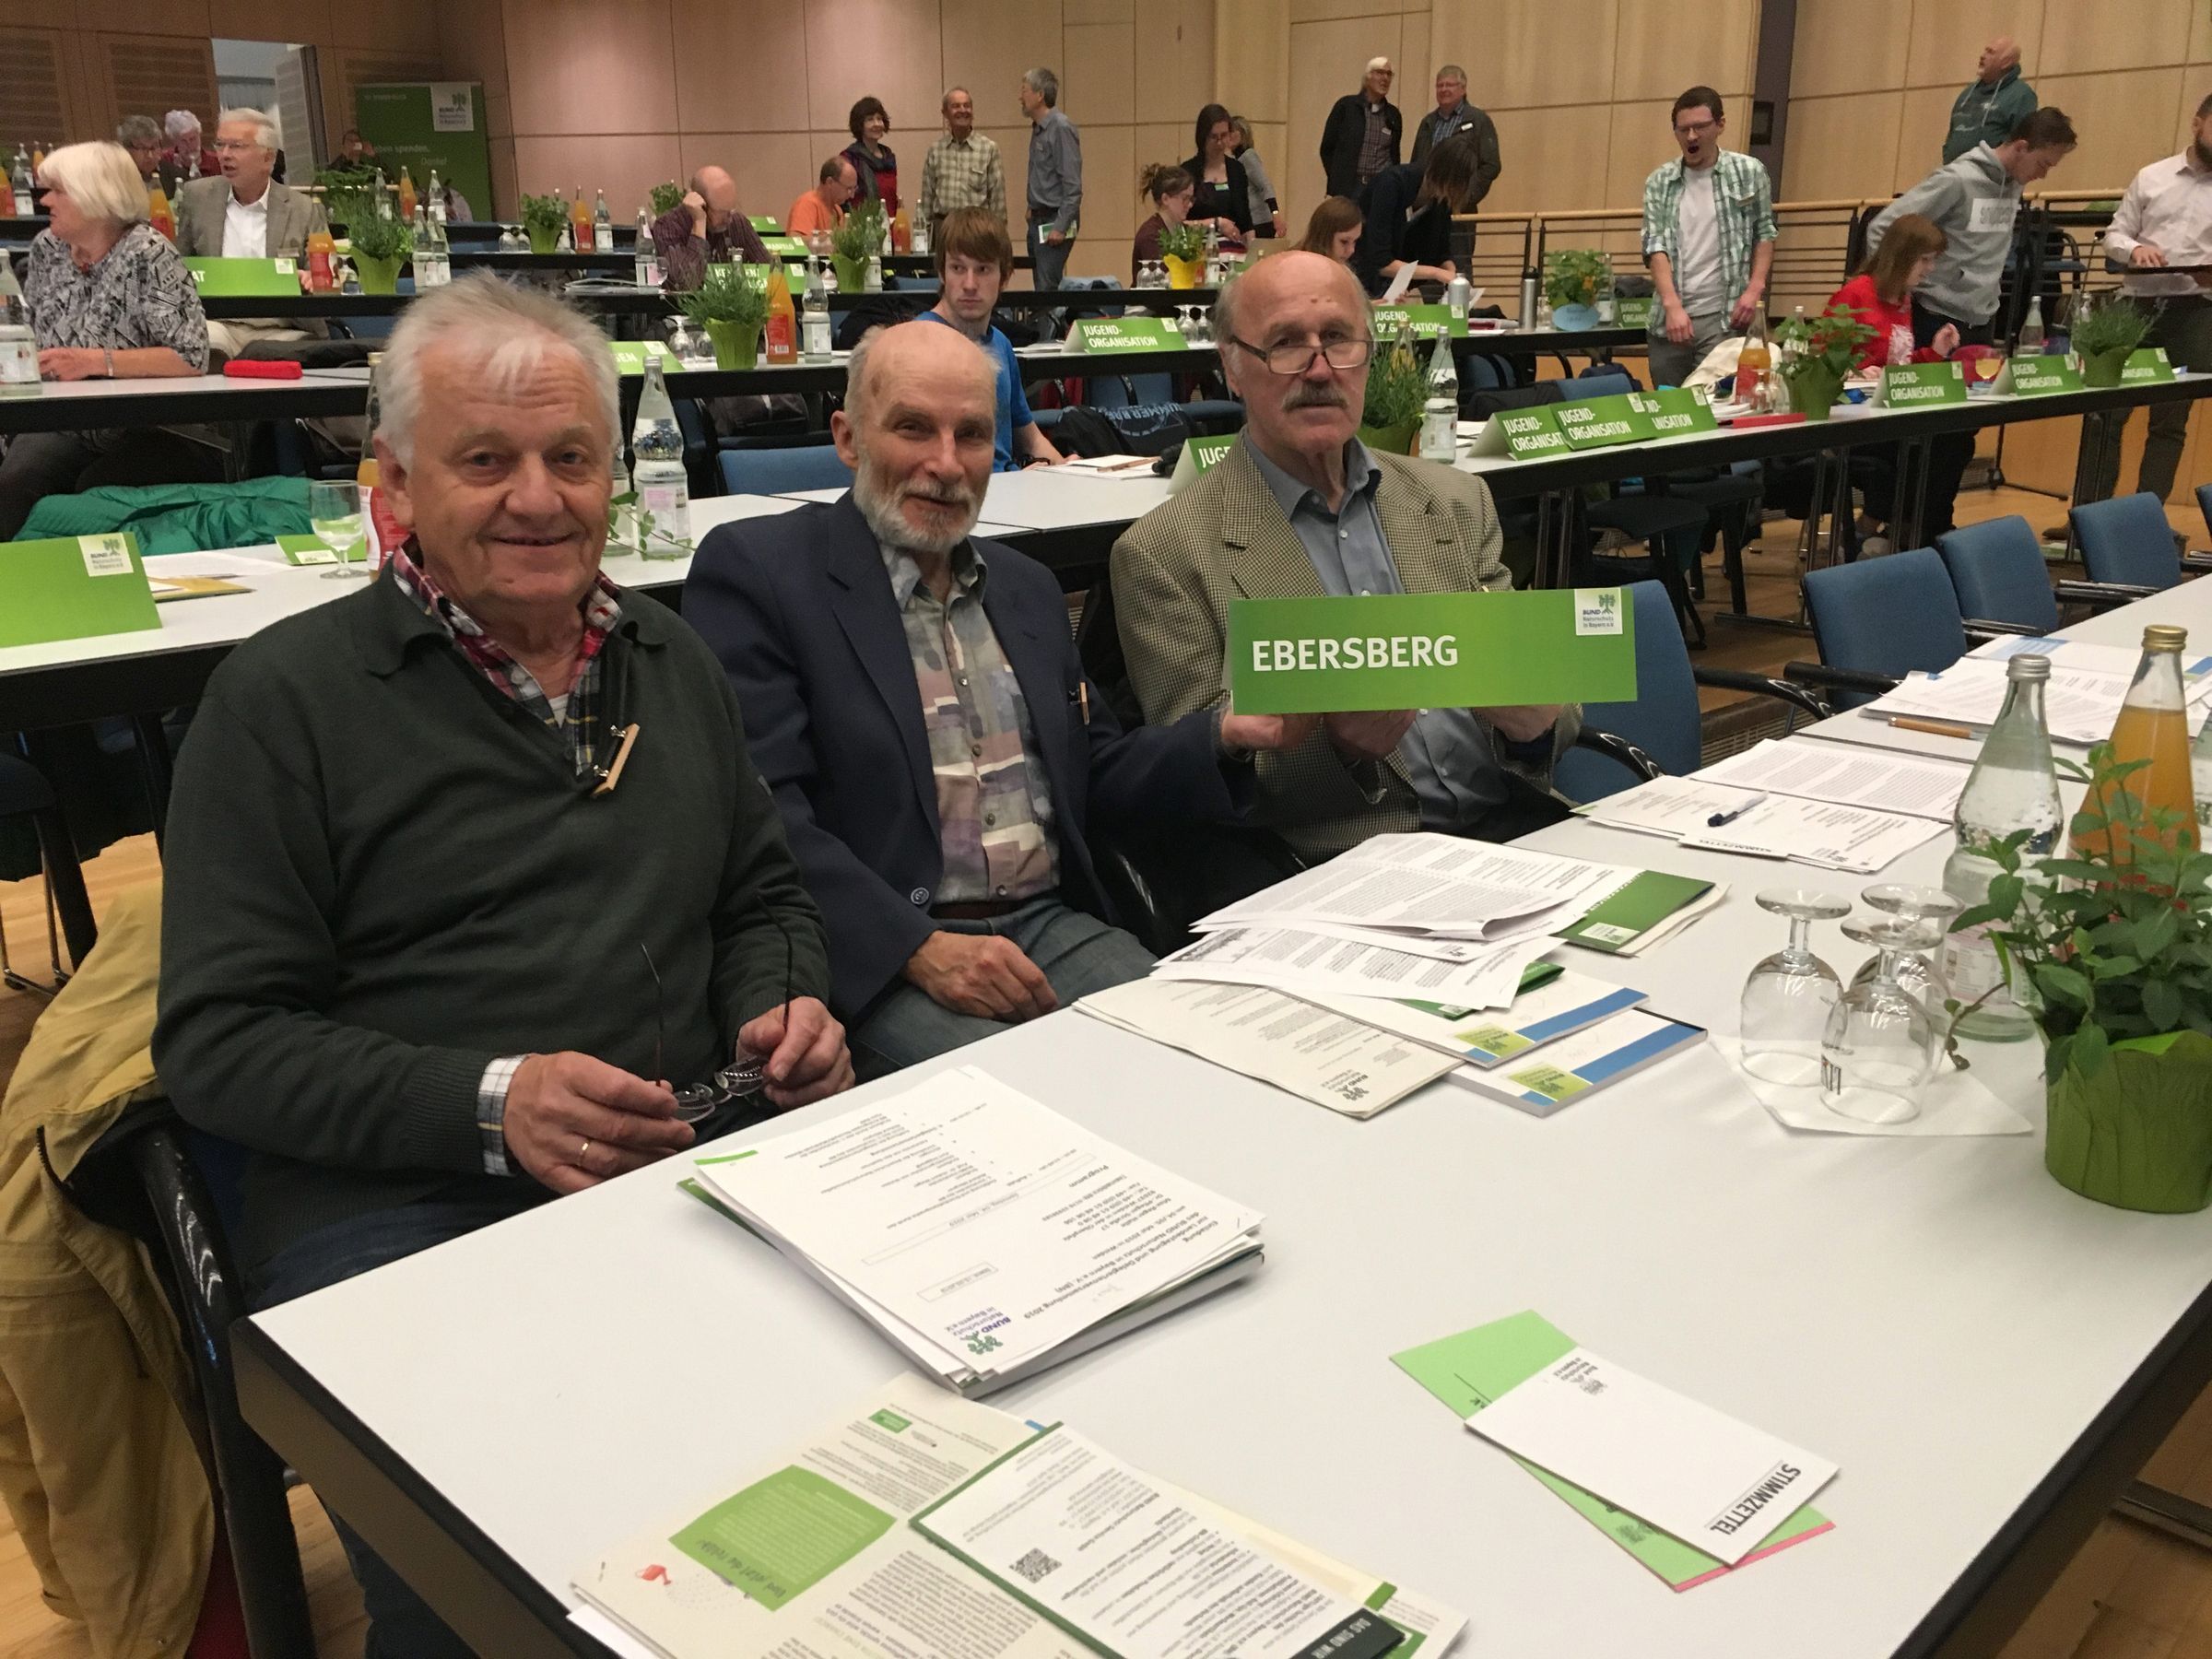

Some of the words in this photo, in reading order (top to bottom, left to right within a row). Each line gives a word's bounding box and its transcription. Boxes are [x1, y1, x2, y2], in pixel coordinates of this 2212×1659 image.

[1375, 312, 1411, 323] JUGEND-
[1083, 324, 1123, 336] JUGEND-
[1376, 323, 1440, 334] OGSATION
[1088, 335, 1159, 347] ORGANISATION
[1889, 371, 1920, 386] JUGEND-
[2016, 376, 2063, 390] ORGANISATION
[1890, 385, 1945, 400] ORGANISATION
[1558, 407, 1595, 425] JUGEND-
[1502, 417, 1543, 436] JUGEND-
[1569, 420, 1632, 441] ORGANISATION
[1512, 431, 1565, 452] ORGANISAT
[1253, 635, 1458, 672] EBERSBERG
[1067, 1163, 1110, 1188] Programm
[957, 1310, 988, 1325] Bayern
[1023, 1305, 1044, 1319] 2019
[951, 1309, 1004, 1336] Naturschutz
[980, 1315, 1011, 1333] BUND
[1709, 1463, 1801, 1535] STIMMZETTEL
[1347, 1617, 1371, 1633] DAS
[1328, 1628, 1355, 1647] SIND
[1311, 1643, 1335, 1659] WIR
